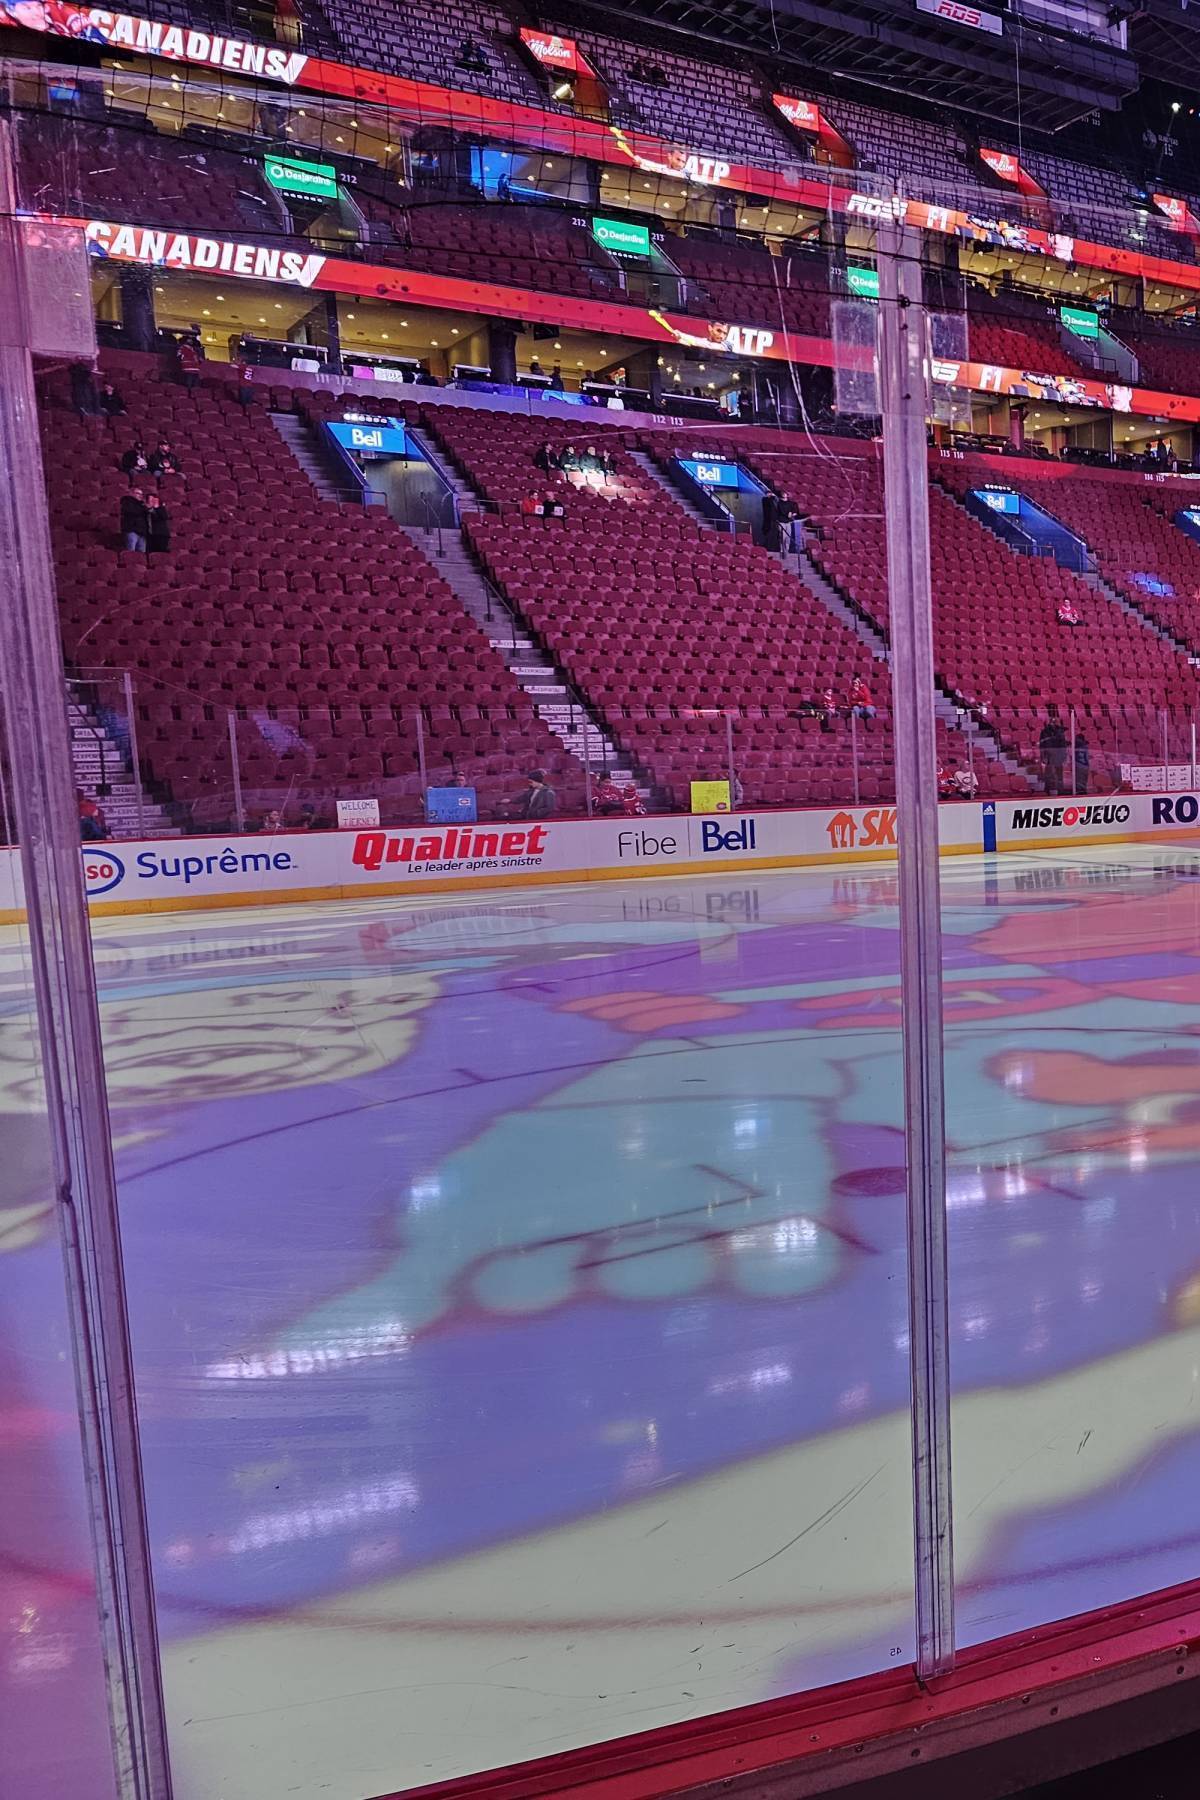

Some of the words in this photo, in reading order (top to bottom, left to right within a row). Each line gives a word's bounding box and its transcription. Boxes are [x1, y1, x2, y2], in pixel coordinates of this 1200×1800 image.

[939, 2, 981, 26] RDS
[89, 9, 292, 83] CANADIENS
[530, 40, 573, 60] Molson
[285, 168, 332, 187] Desjardins
[340, 173, 358, 184] 212
[686, 155, 730, 183] ATP
[571, 217, 588, 228] 212
[927, 205, 948, 229] F1
[650, 232, 666, 243] 213
[87, 222, 304, 282] CANADIENS
[727, 325, 774, 354] ATP
[980, 365, 1002, 389] F1
[652, 414, 667, 424] 112
[671, 416, 684, 426] 113
[352, 429, 384, 448] Bell
[697, 464, 722, 483] Bell
[341, 800, 377, 811] WELCOME
[618, 830, 678, 858] Fibe
[702, 818, 756, 852] Bell
[352, 825, 547, 871] Qualinet
[137, 847, 293, 883] Suprême
[407, 863, 420, 873] Le
[421, 859, 463, 873] leader
[465, 859, 498, 875] après
[500, 855, 542, 869] sinistre
